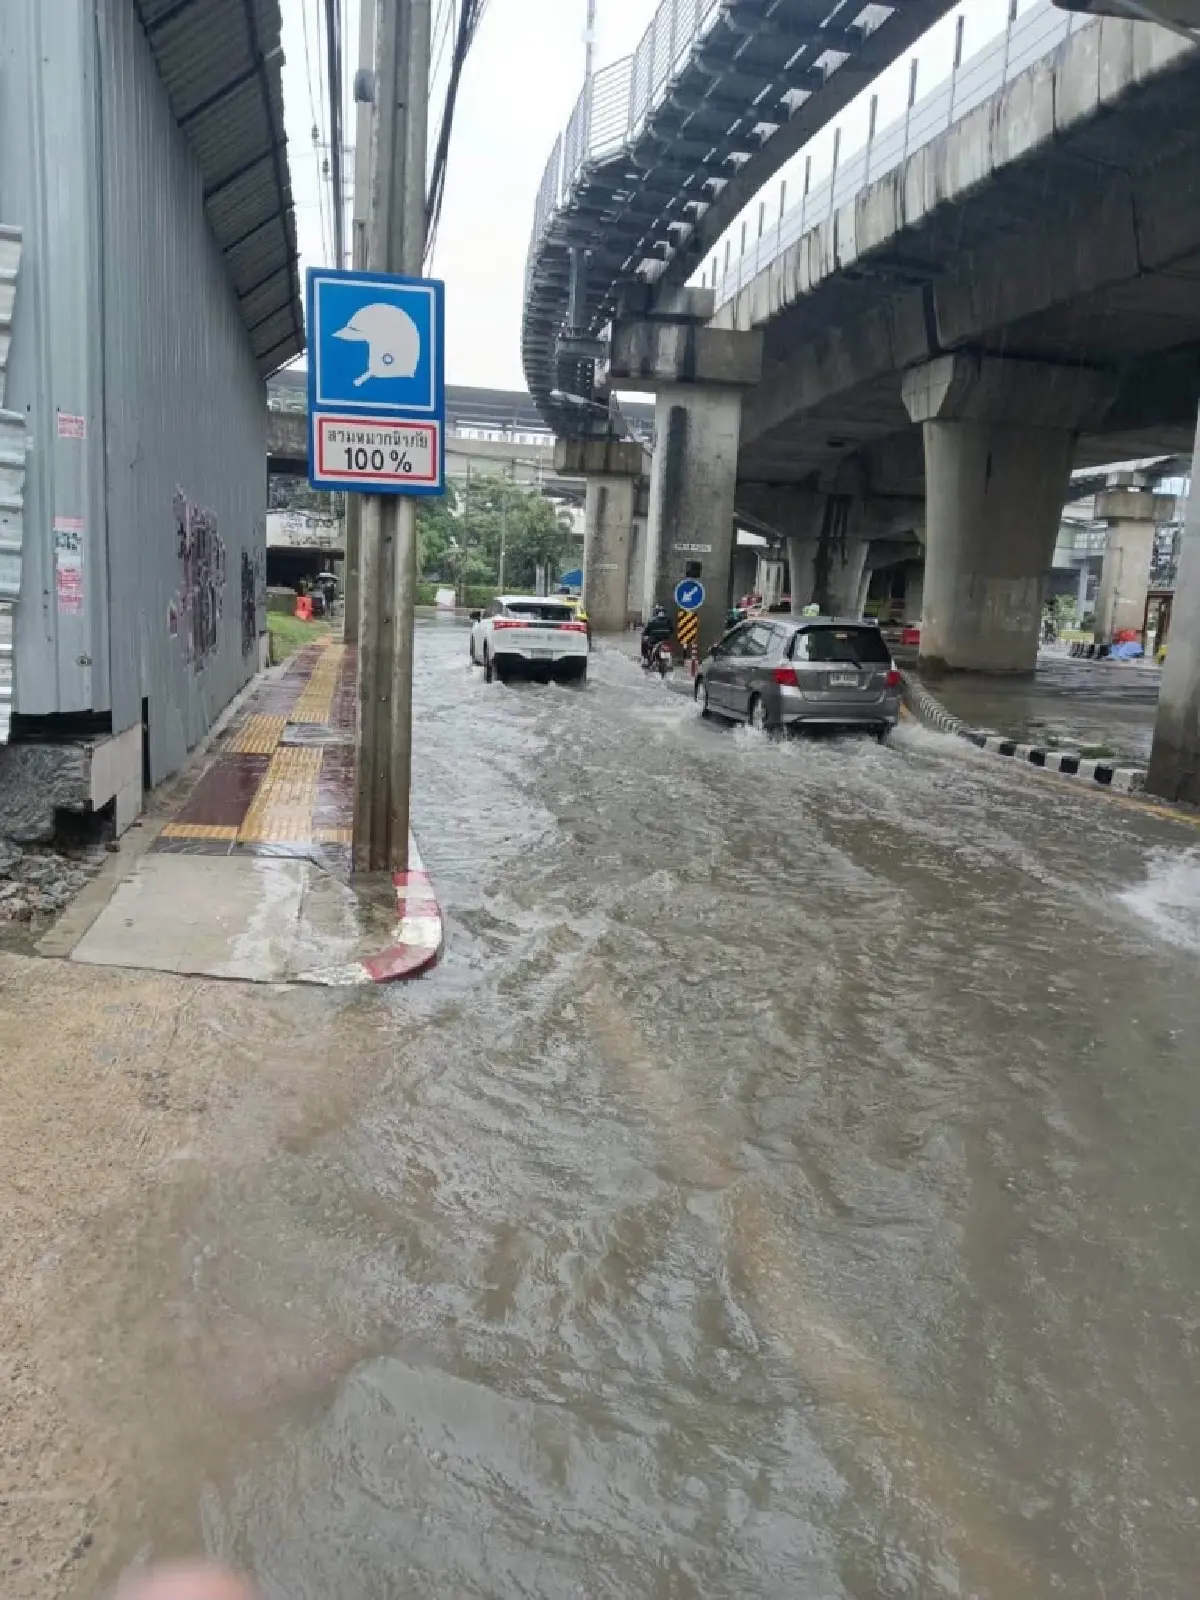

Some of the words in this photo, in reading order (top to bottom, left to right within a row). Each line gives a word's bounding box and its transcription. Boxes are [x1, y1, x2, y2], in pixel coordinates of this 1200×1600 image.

[327, 430, 428, 448] สวมหมวกนิรภัย
